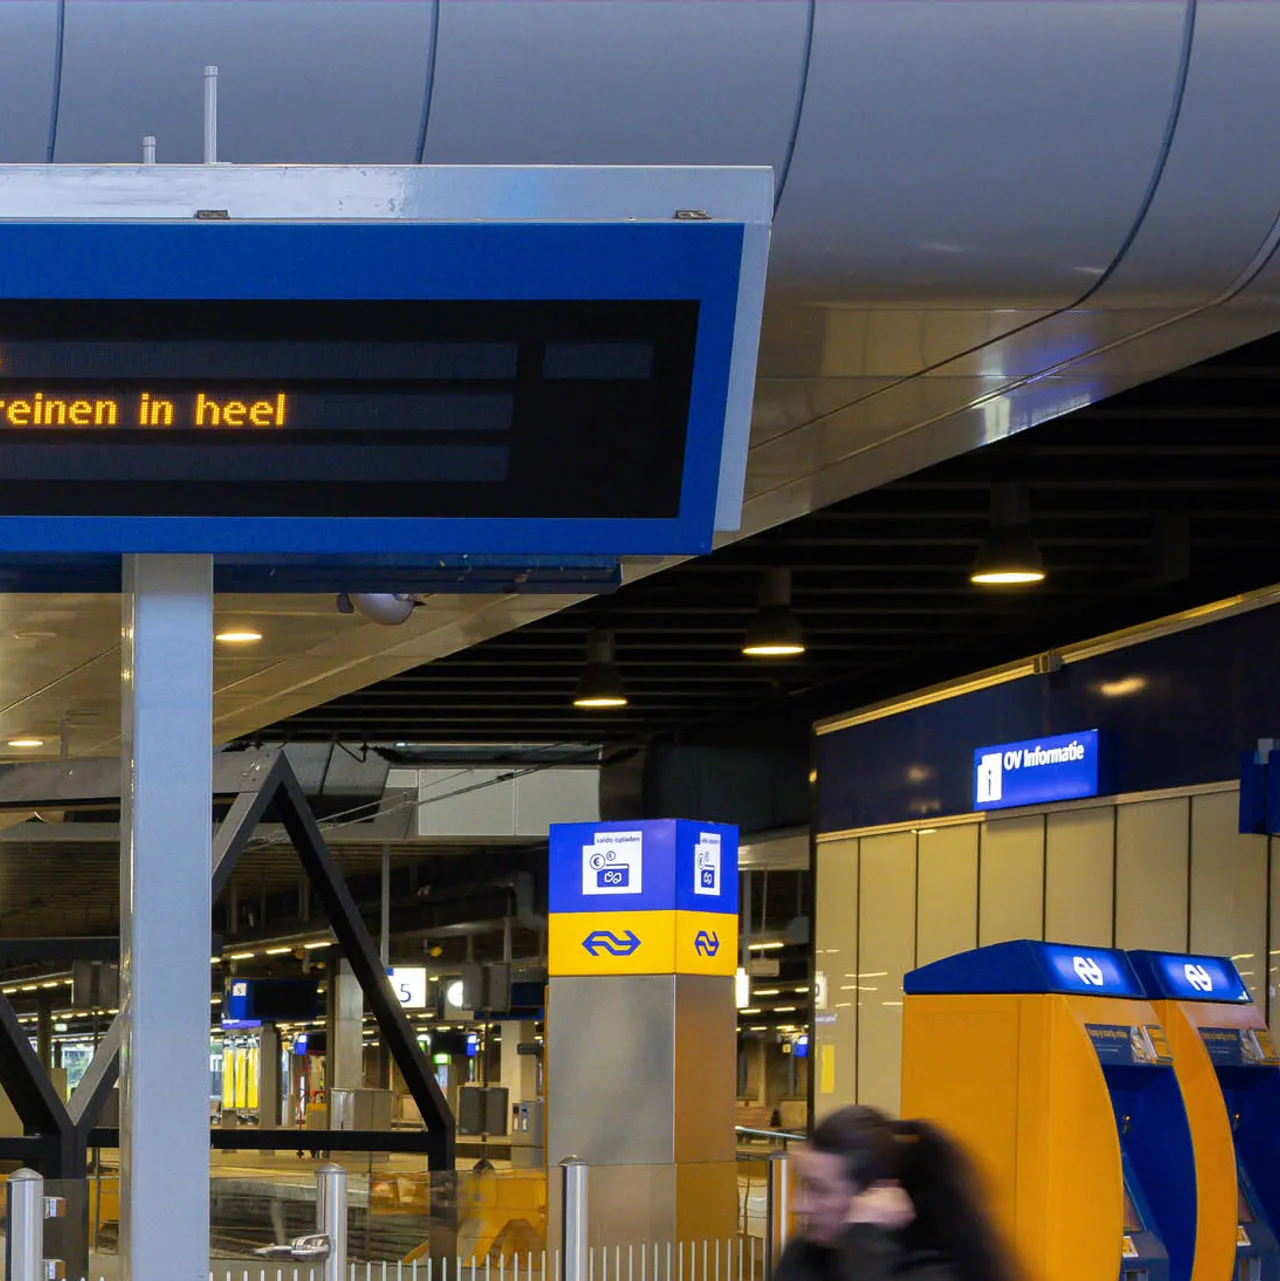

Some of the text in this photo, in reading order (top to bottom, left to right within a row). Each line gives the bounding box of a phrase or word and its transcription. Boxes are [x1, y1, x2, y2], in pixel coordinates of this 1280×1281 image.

[139, 392, 174, 425] in
[195, 392, 286, 426] heel
[1003, 740, 1085, 771] OV Informatie
[400, 983, 412, 1003] 5
